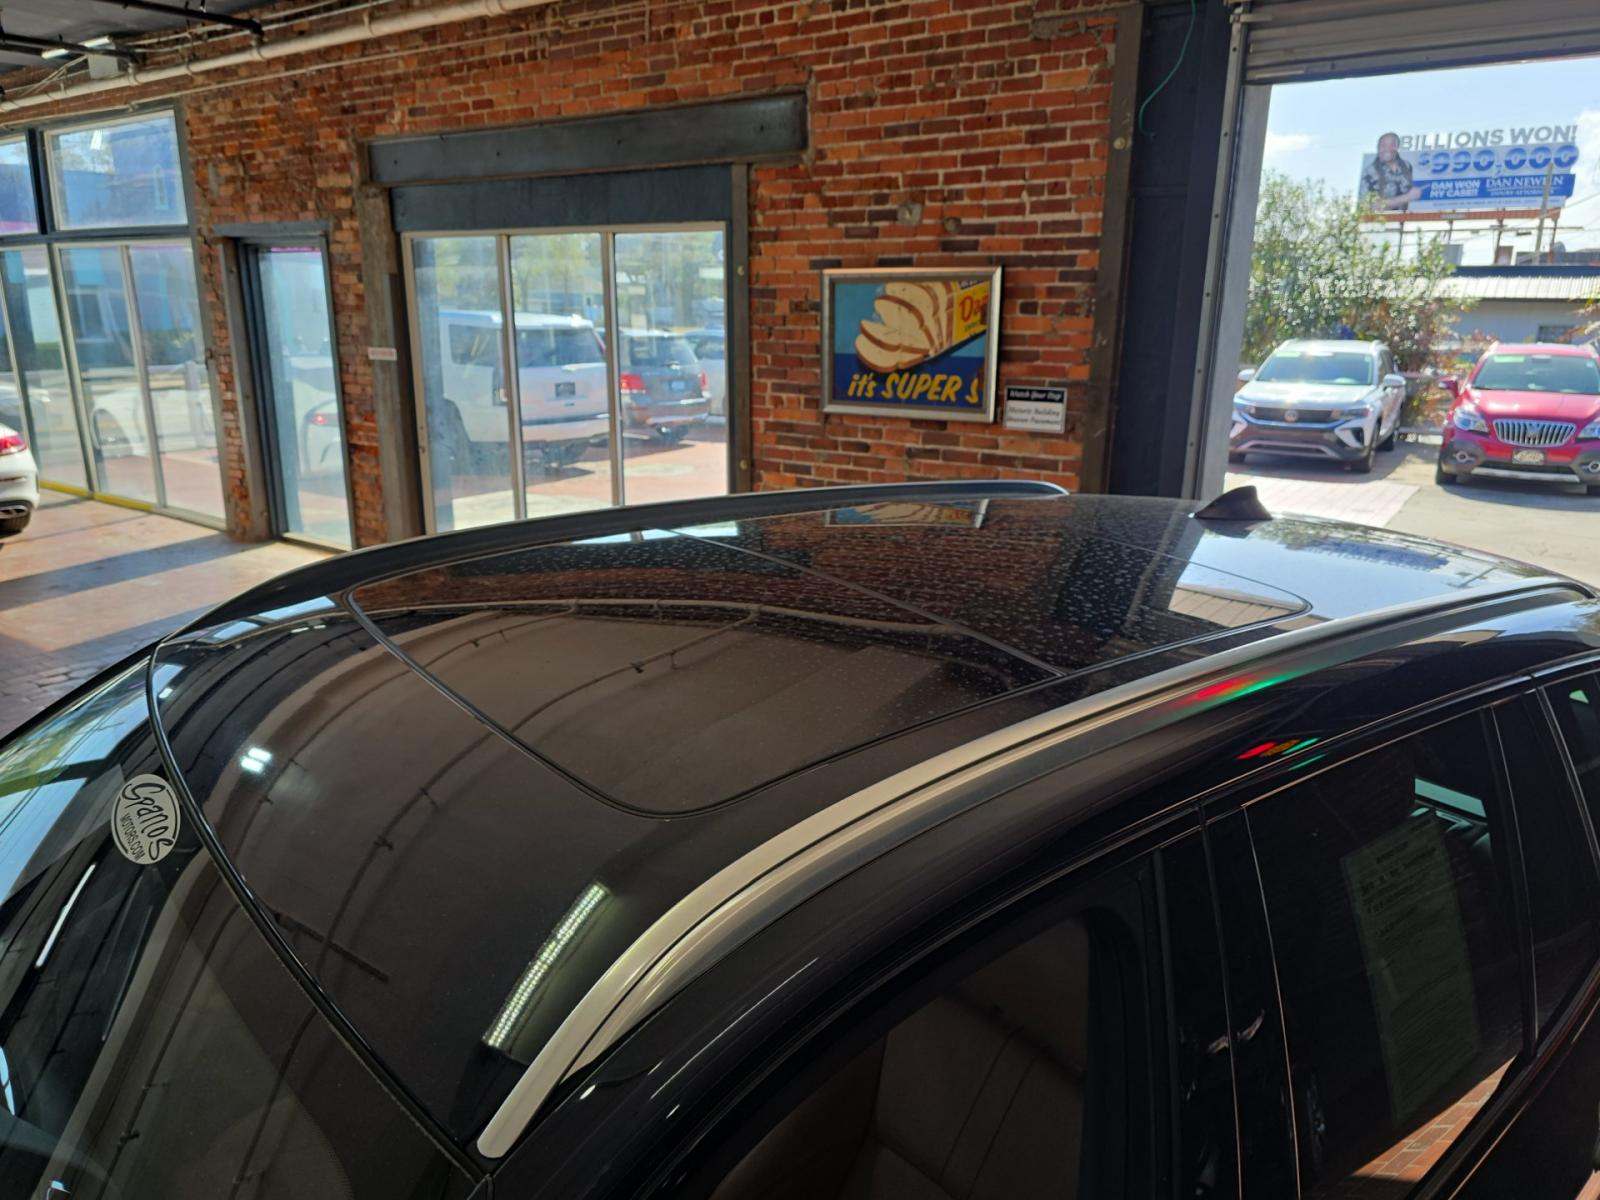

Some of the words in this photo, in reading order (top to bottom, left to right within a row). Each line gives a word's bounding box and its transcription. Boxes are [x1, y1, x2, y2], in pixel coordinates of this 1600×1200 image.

[1400, 129, 1504, 151] BILLIONS
[1510, 125, 1578, 144] WON!
[1418, 145, 1580, 177] $990,000
[1486, 178, 1512, 188] DAN
[847, 372, 877, 398] it's
[881, 372, 962, 402] SUPER
[120, 812, 146, 861] MOTORS.COM
[122, 782, 174, 861] Spanos
